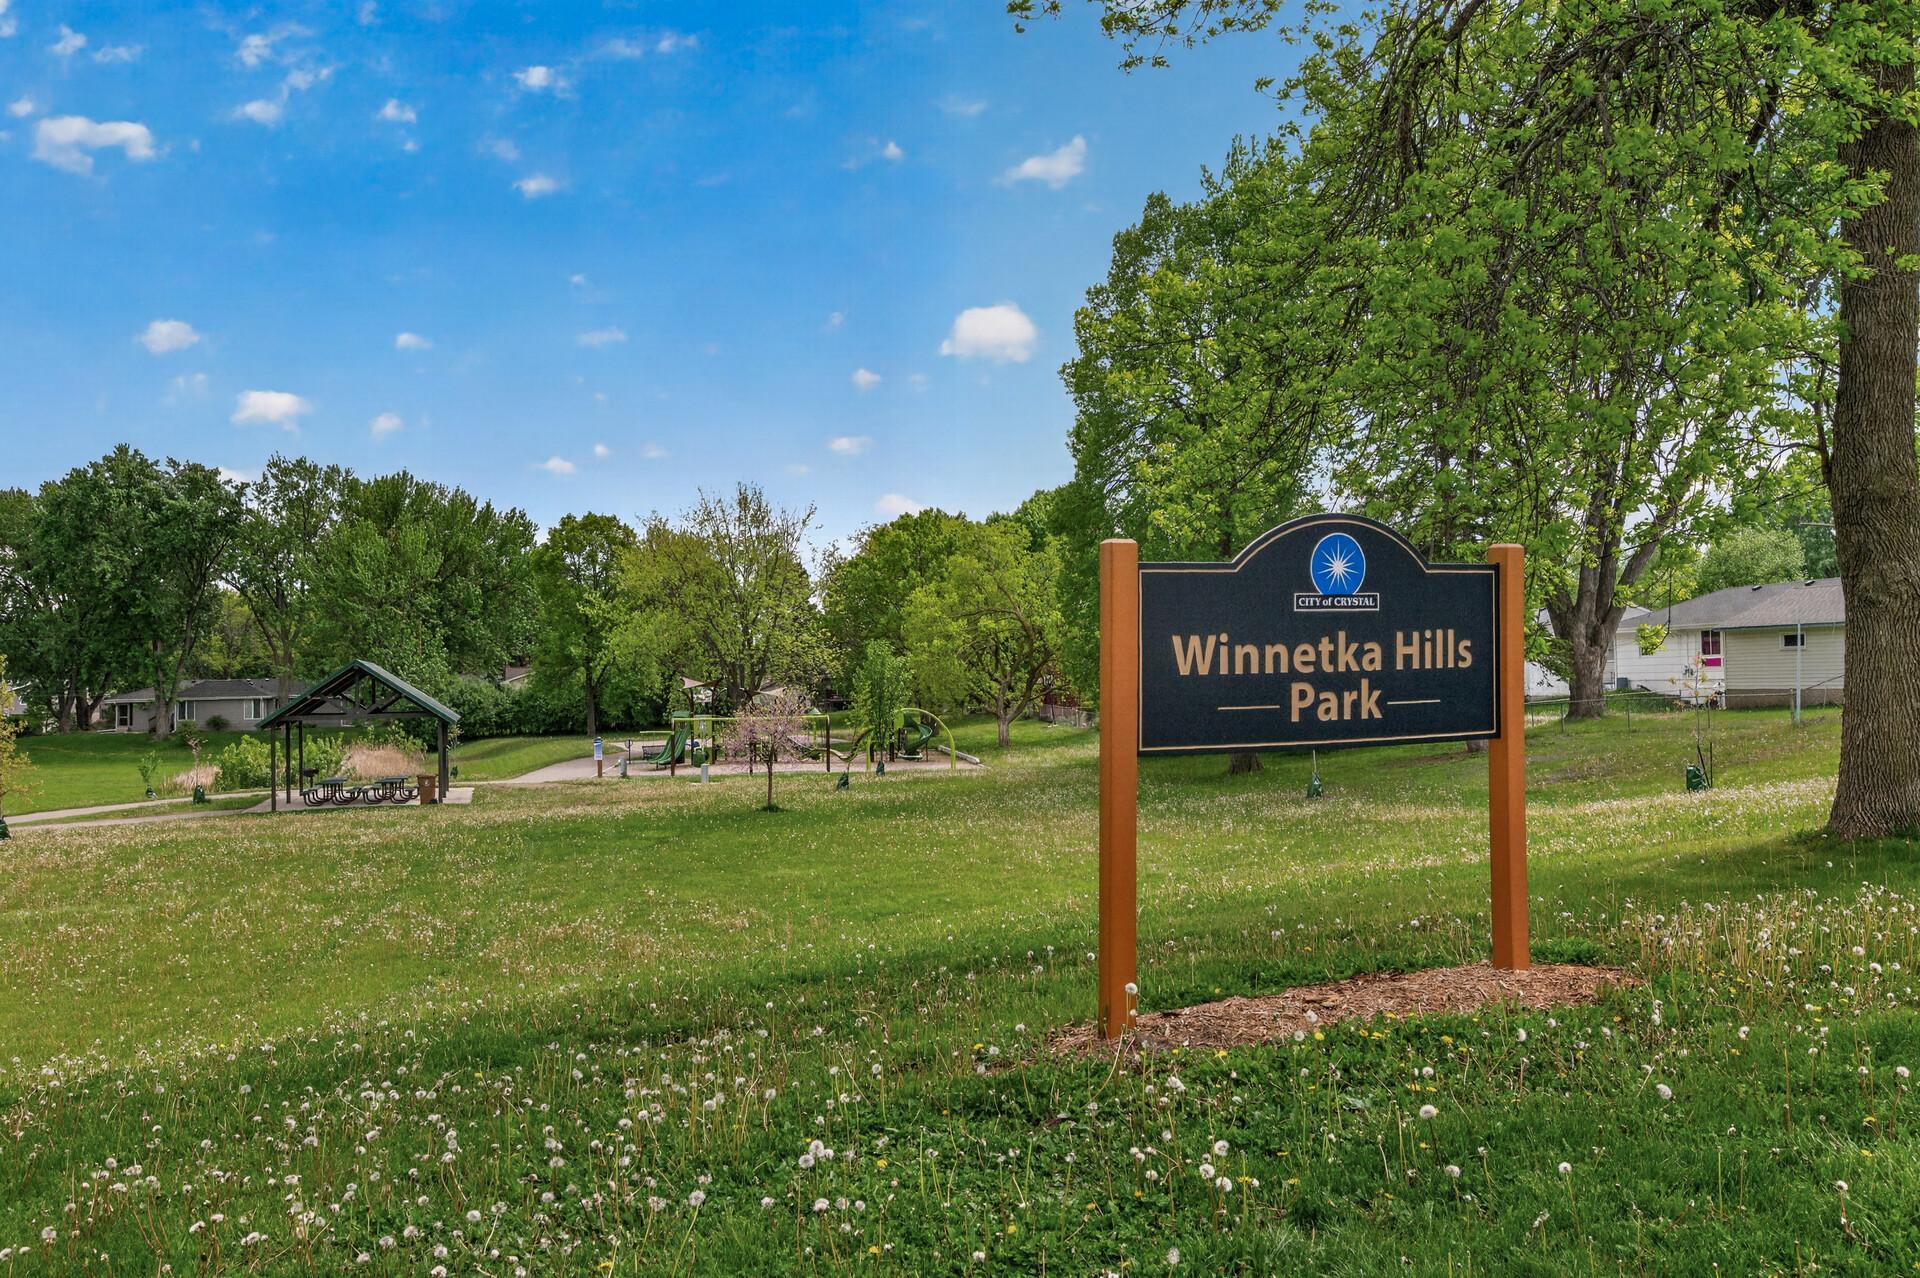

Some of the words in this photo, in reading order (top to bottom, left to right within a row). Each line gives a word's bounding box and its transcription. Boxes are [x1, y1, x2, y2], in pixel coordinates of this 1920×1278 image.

[1298, 597, 1321, 606] CITY
[1322, 597, 1332, 606] of
[1334, 597, 1375, 606] CRYSTAL
[1171, 630, 1383, 676] Winnetka
[1395, 628, 1473, 671] Hills
[1290, 678, 1383, 723] Park
